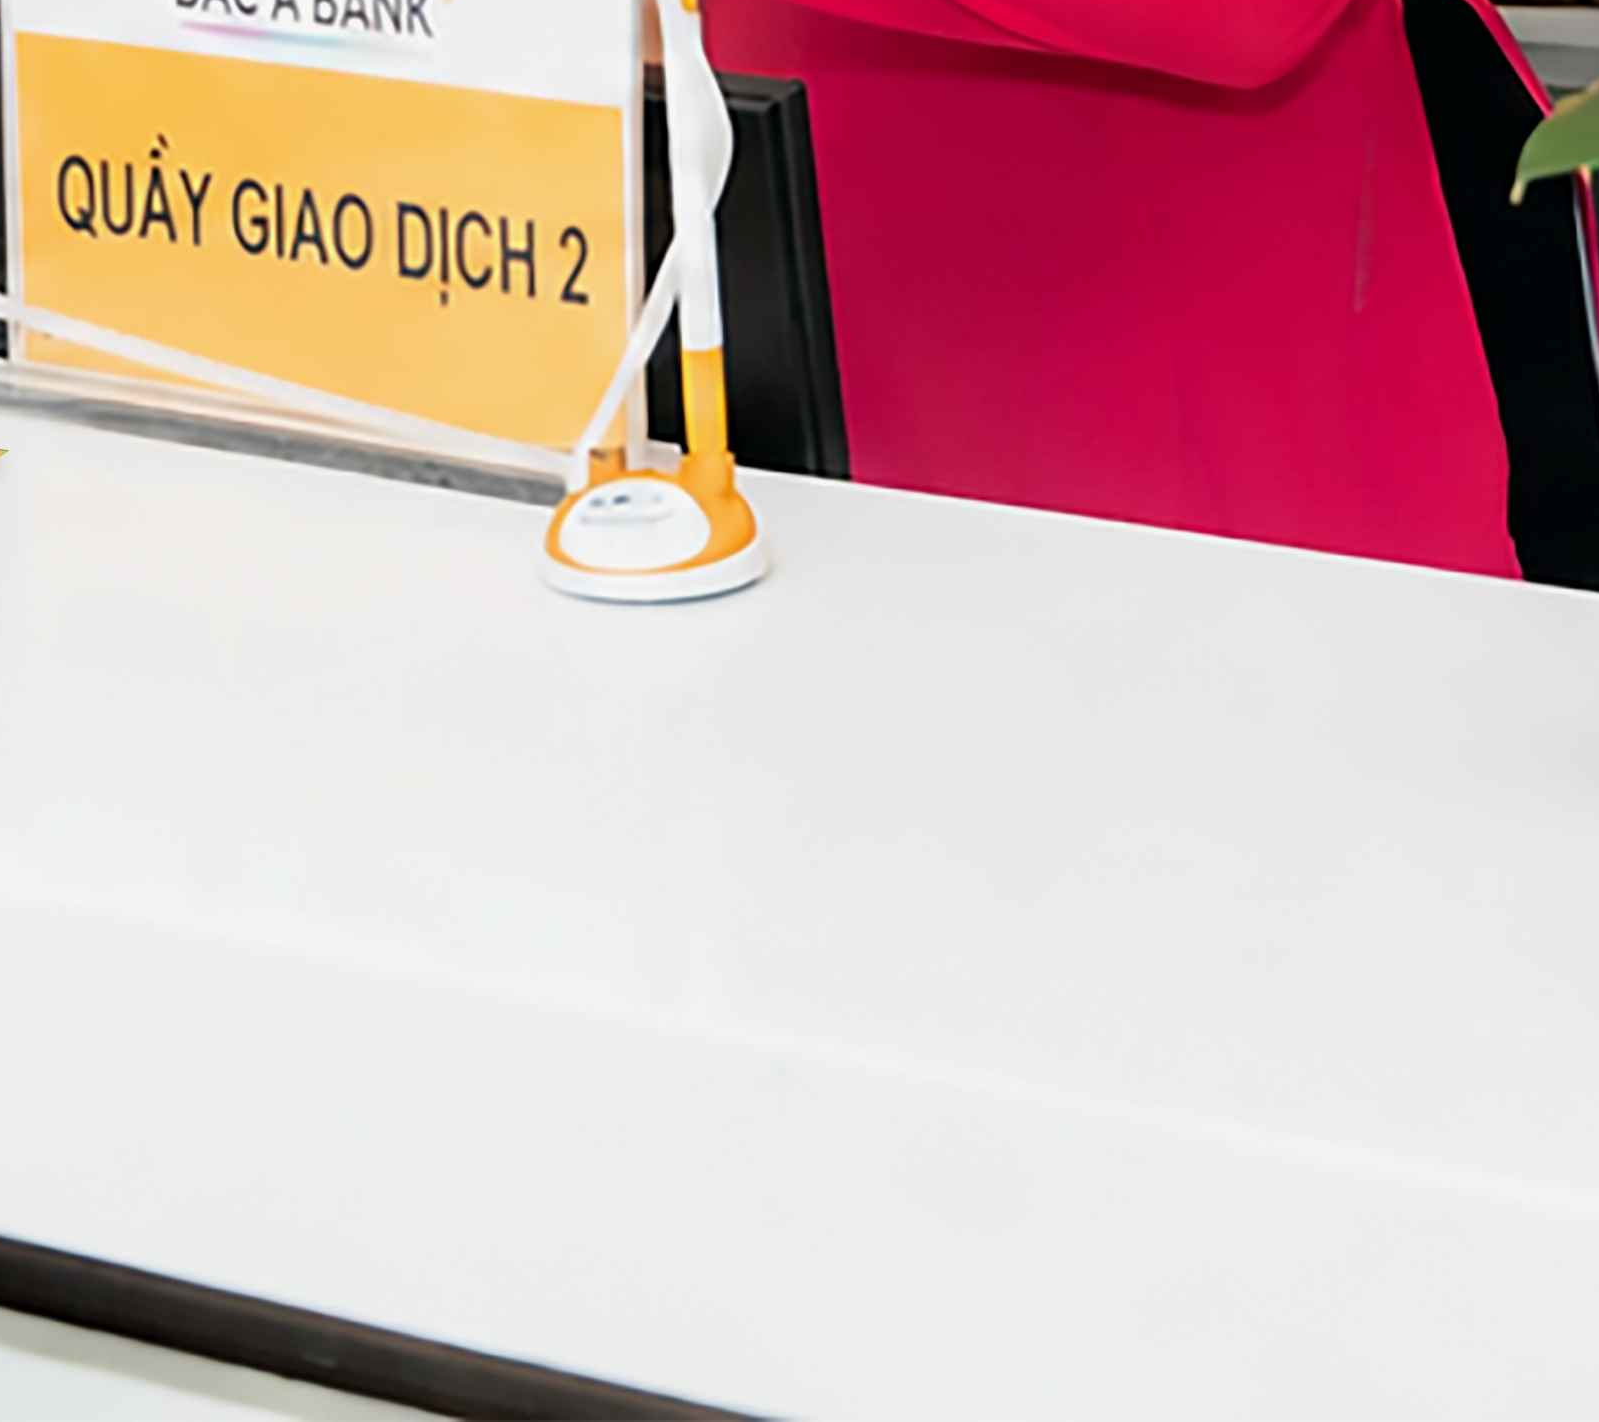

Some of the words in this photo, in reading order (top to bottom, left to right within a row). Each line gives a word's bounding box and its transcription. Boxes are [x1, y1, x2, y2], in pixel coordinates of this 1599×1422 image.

[57, 133, 212, 248] QUẦY
[231, 177, 374, 271] GIAO
[397, 199, 538, 307] DỊCH
[559, 224, 590, 306] 2
